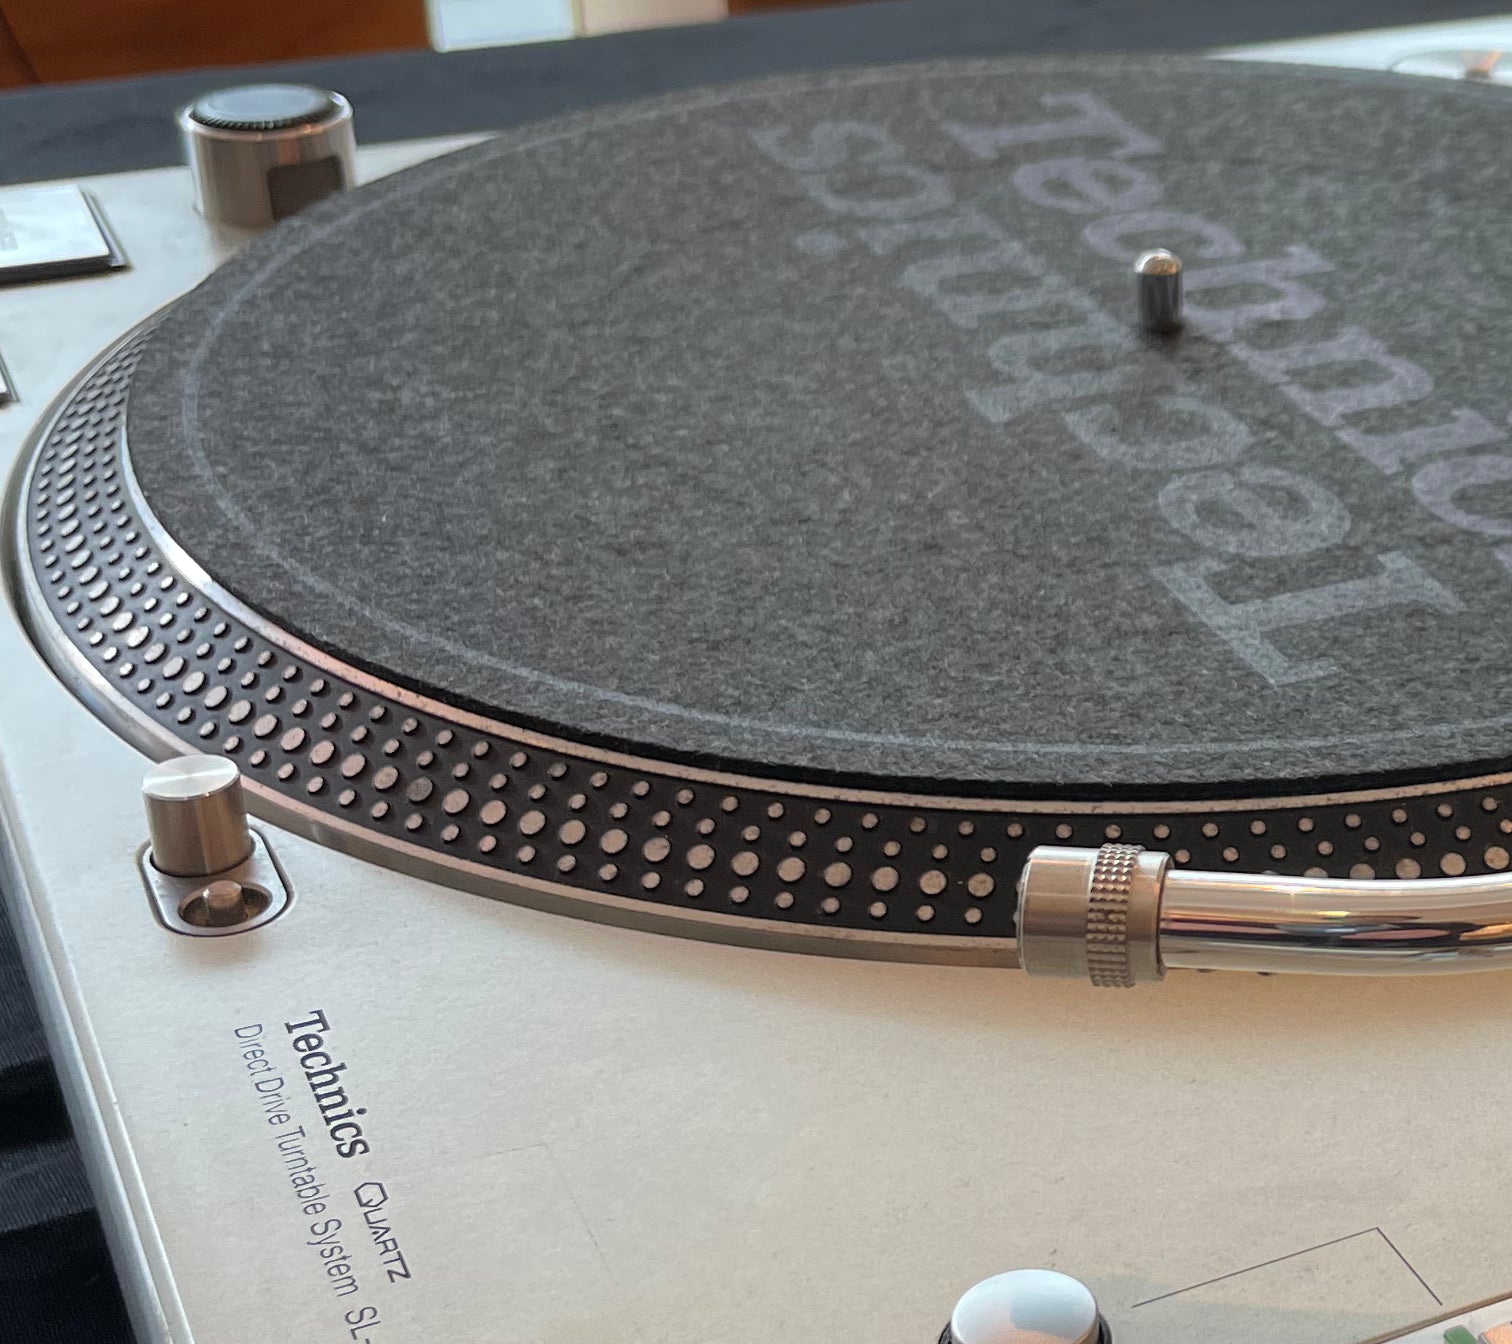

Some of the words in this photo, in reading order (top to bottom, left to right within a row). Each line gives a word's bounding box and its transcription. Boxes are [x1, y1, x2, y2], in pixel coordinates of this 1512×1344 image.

[747, 119, 1469, 690] Technics
[234, 1023, 273, 1077] Direct
[254, 1076, 291, 1127] Drive
[275, 1124, 327, 1216] Turntable
[306, 1217, 360, 1299] System
[284, 1009, 371, 1159] Technics
[353, 1181, 412, 1284] QUARTZ
